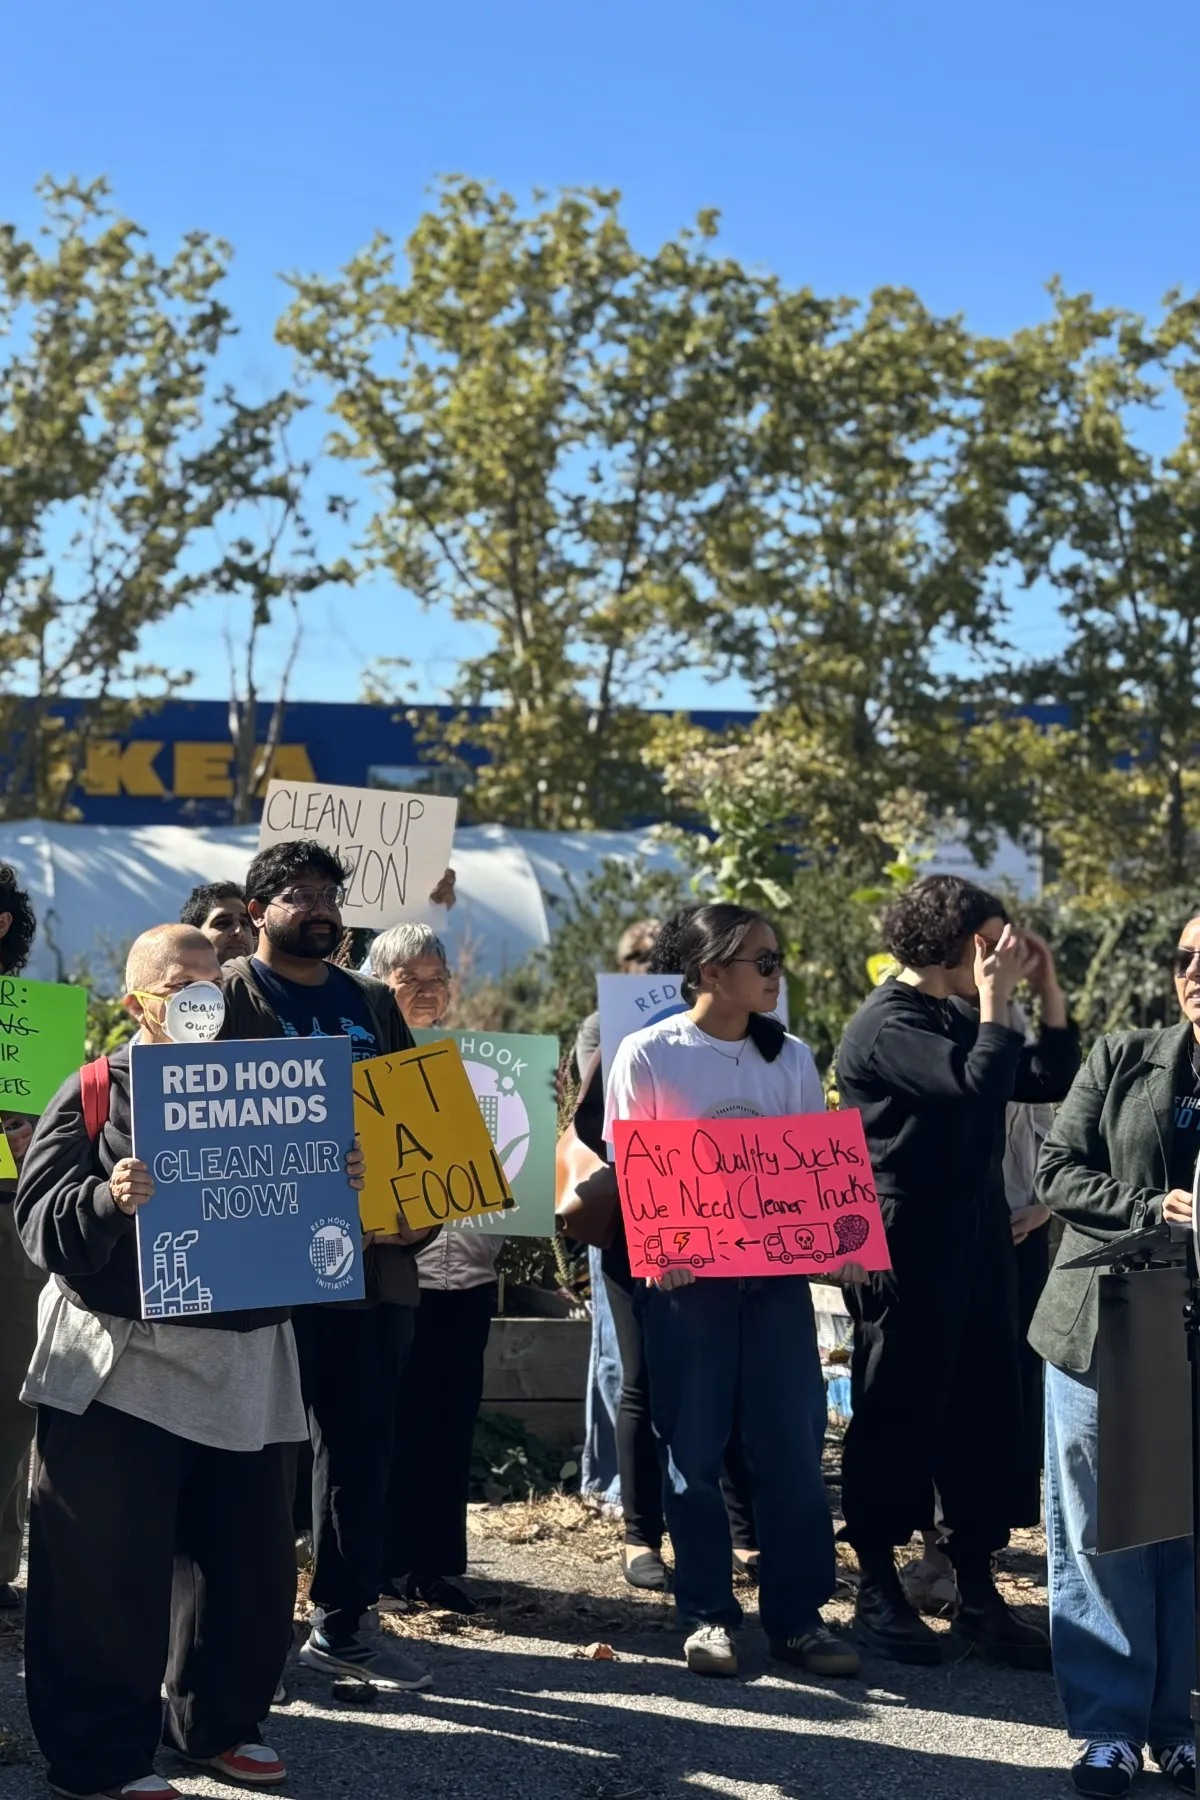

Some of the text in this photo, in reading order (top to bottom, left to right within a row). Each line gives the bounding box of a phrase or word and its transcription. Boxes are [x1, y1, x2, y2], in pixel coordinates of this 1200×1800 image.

[84, 740, 317, 797] KEA
[266, 789, 425, 846] CLEAN UP
[344, 845, 409, 912] ZON
[634, 984, 677, 1012] RED
[162, 1058, 326, 1095] RED HOOK
[461, 1037, 528, 1077] HOOK
[164, 1094, 327, 1131] DEMANDS
[153, 1140, 340, 1184] CLEAN AIR
[395, 1123, 433, 1170] A
[623, 1129, 865, 1177] Air Quality Sucks,
[201, 1182, 298, 1221] NOW!
[389, 1148, 515, 1220] FOOL!
[624, 1168, 876, 1221] We Need Cleaner Trucks
[310, 1217, 351, 1233] RED HOOK
[315, 1274, 354, 1290] INITIATIVE
